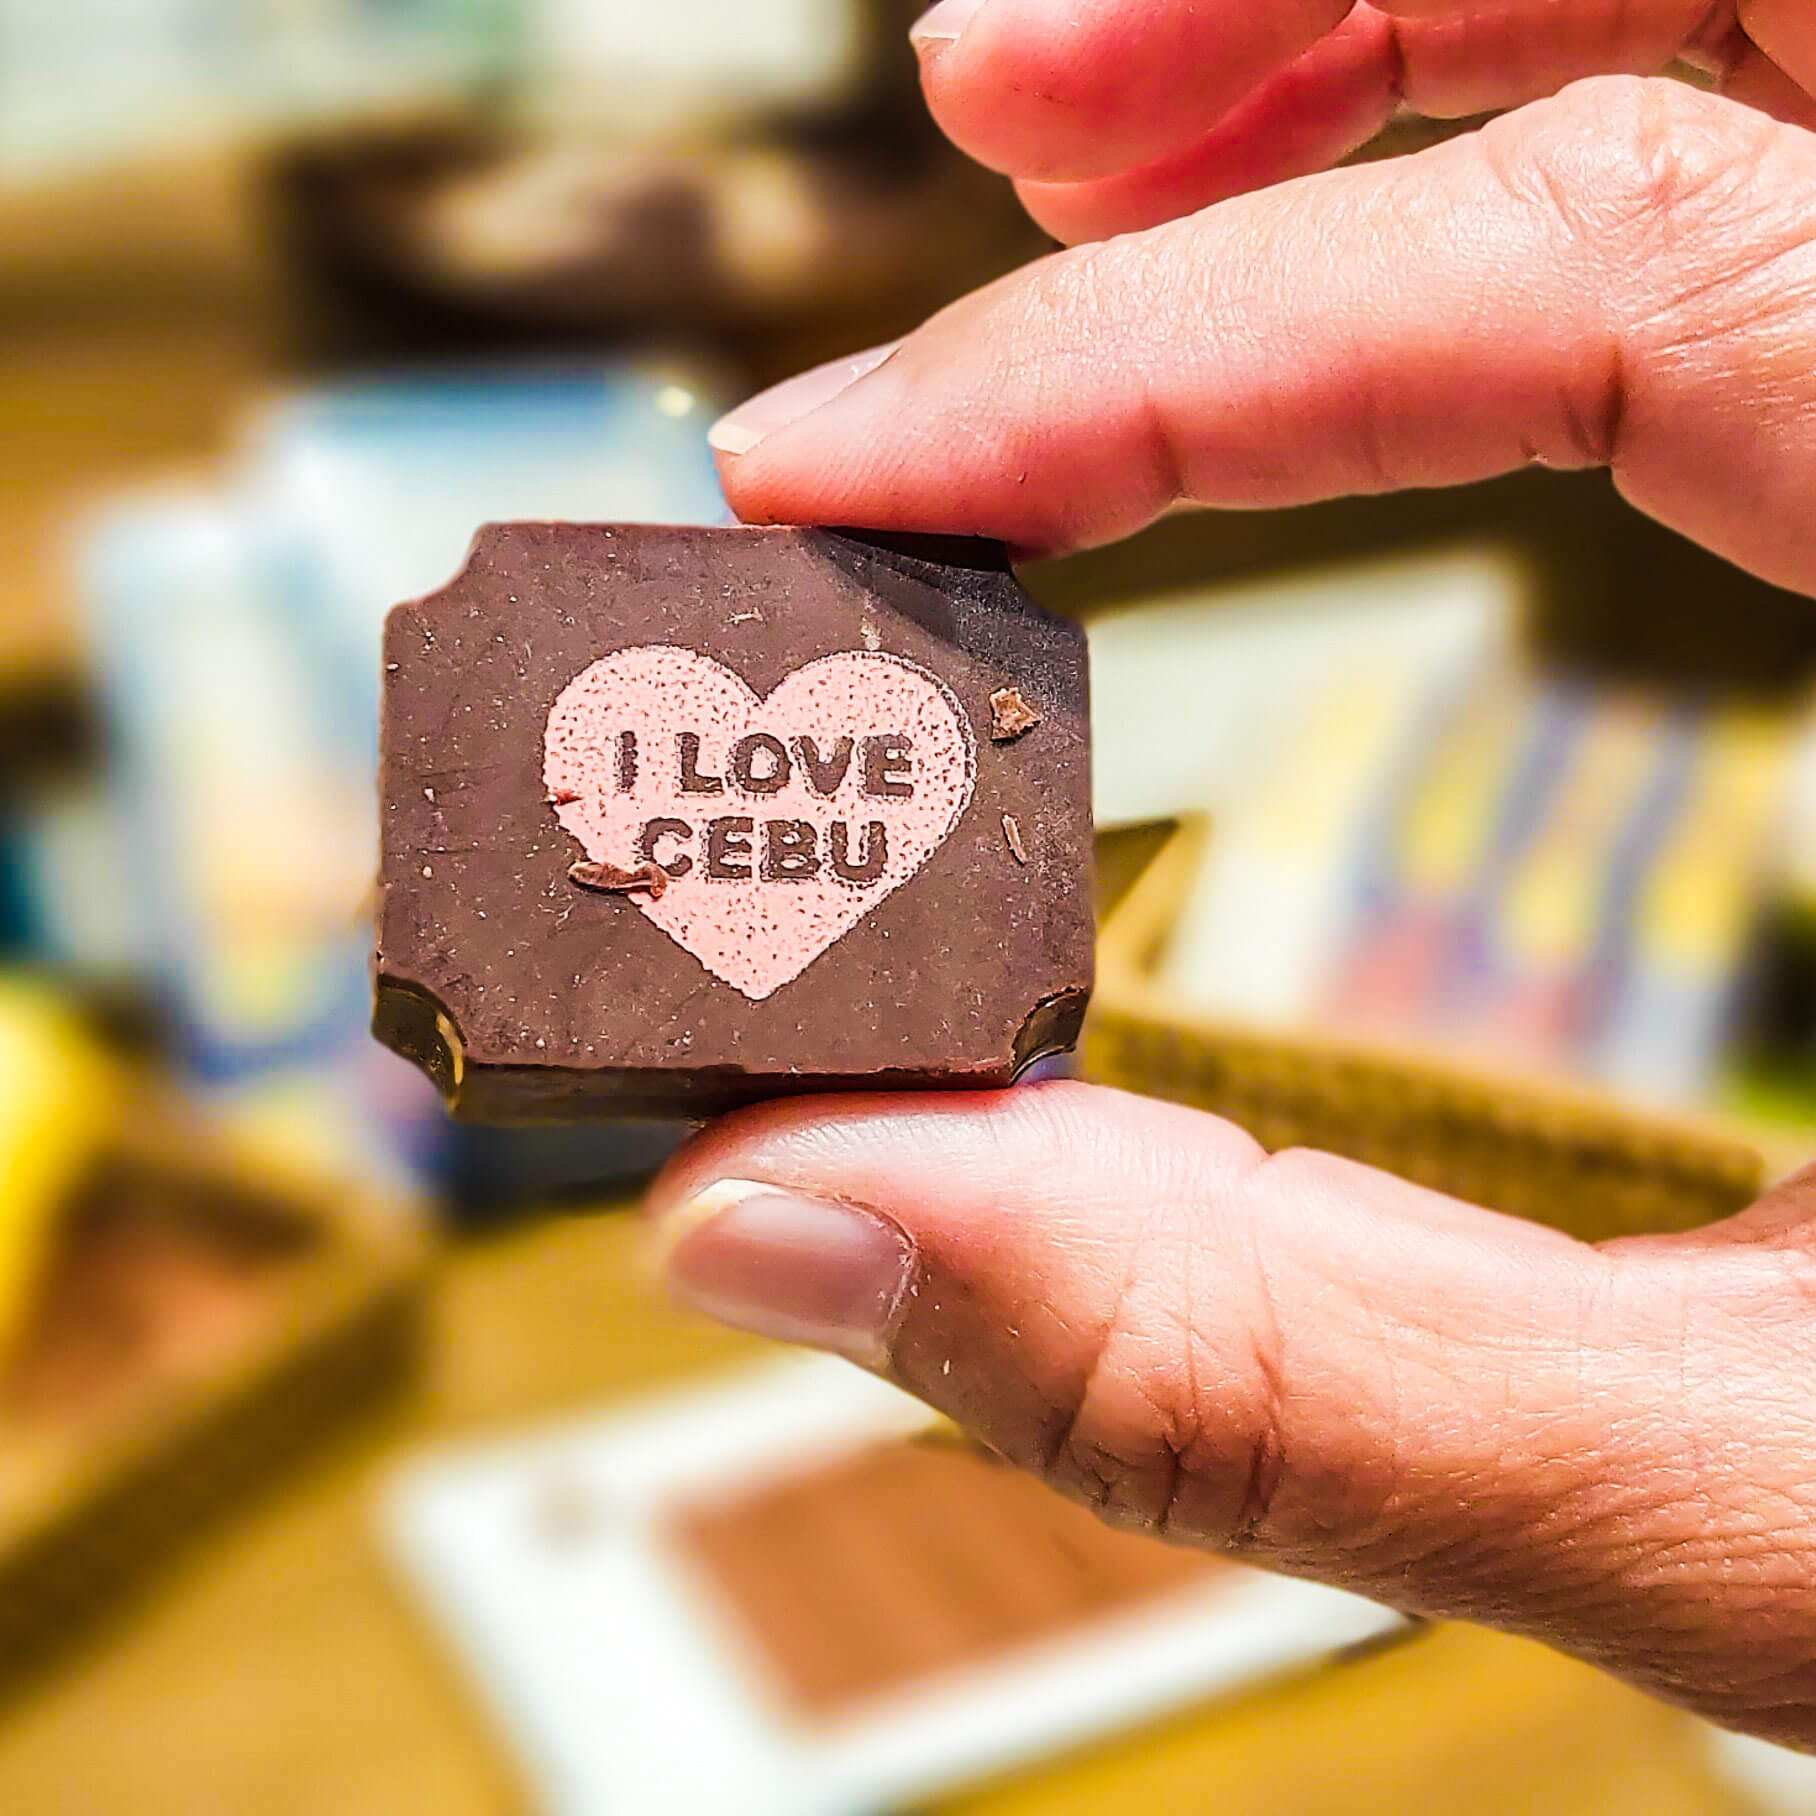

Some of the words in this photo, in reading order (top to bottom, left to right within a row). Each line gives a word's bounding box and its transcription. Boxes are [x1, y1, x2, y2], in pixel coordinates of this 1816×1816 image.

[616, 730, 638, 791] I
[677, 731, 914, 798] LOVE
[640, 816, 888, 883] CEBU
